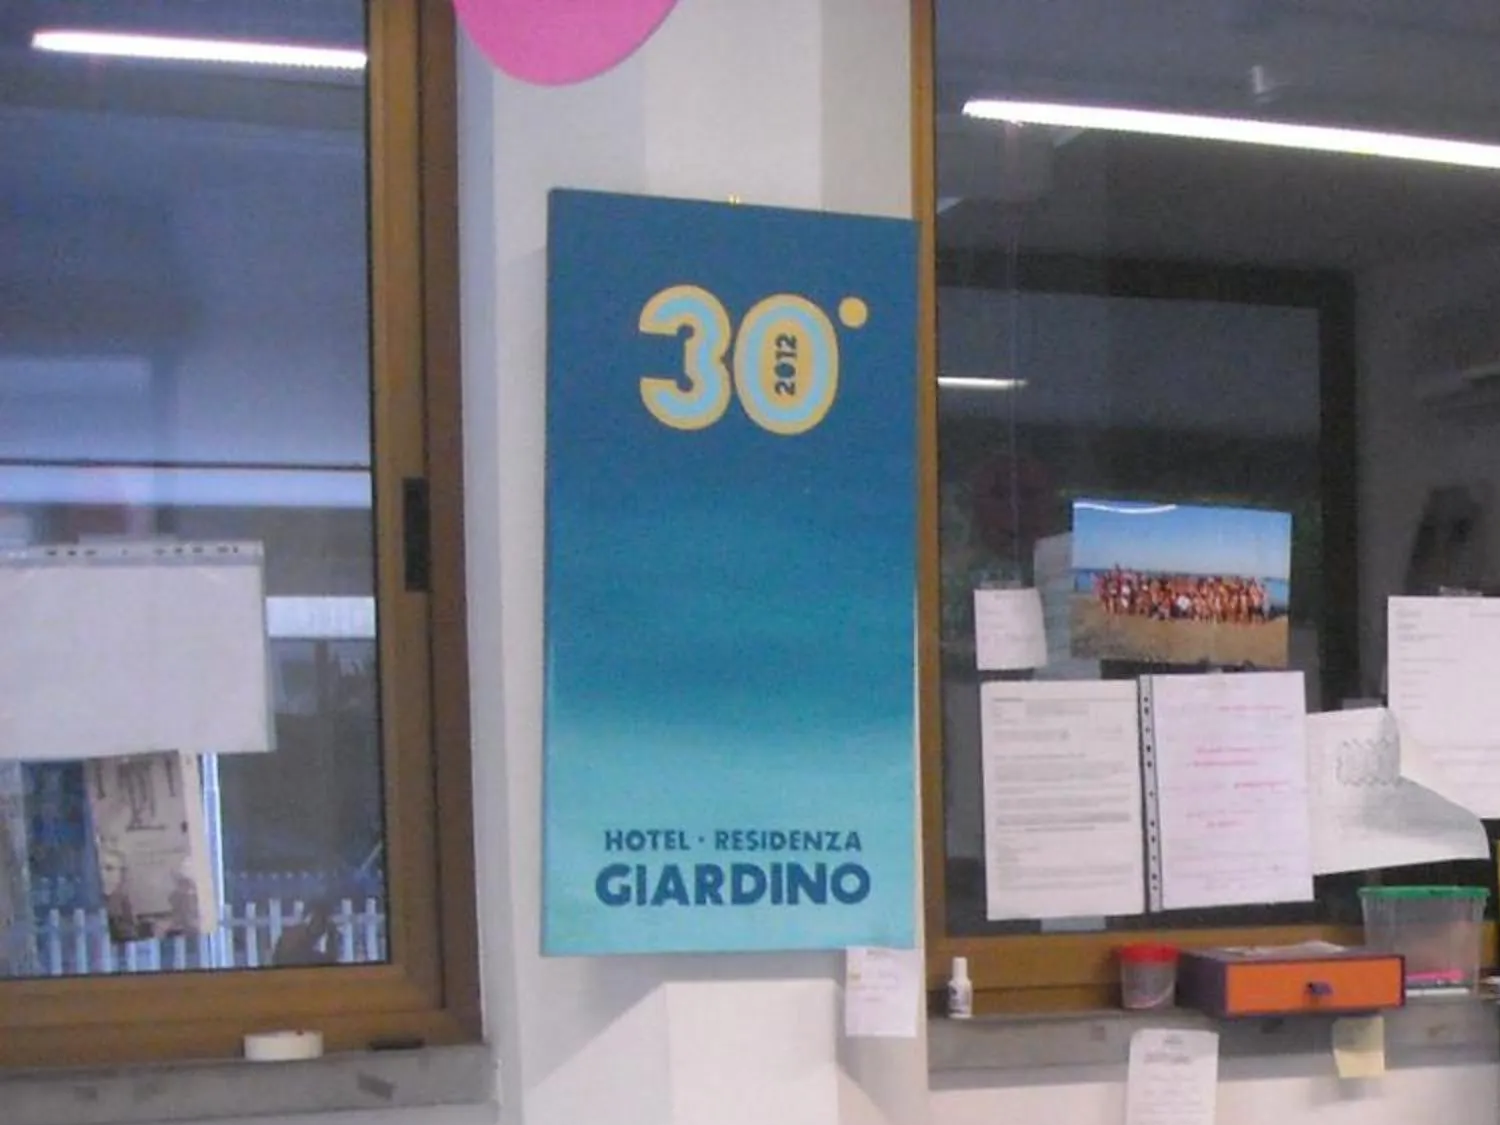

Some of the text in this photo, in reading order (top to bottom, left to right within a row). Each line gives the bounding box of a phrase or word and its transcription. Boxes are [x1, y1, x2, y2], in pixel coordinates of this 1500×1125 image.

[774, 333, 797, 396] 2012
[604, 829, 863, 852] HOTEL RESIDENZA
[595, 862, 871, 907] GIARDINO
